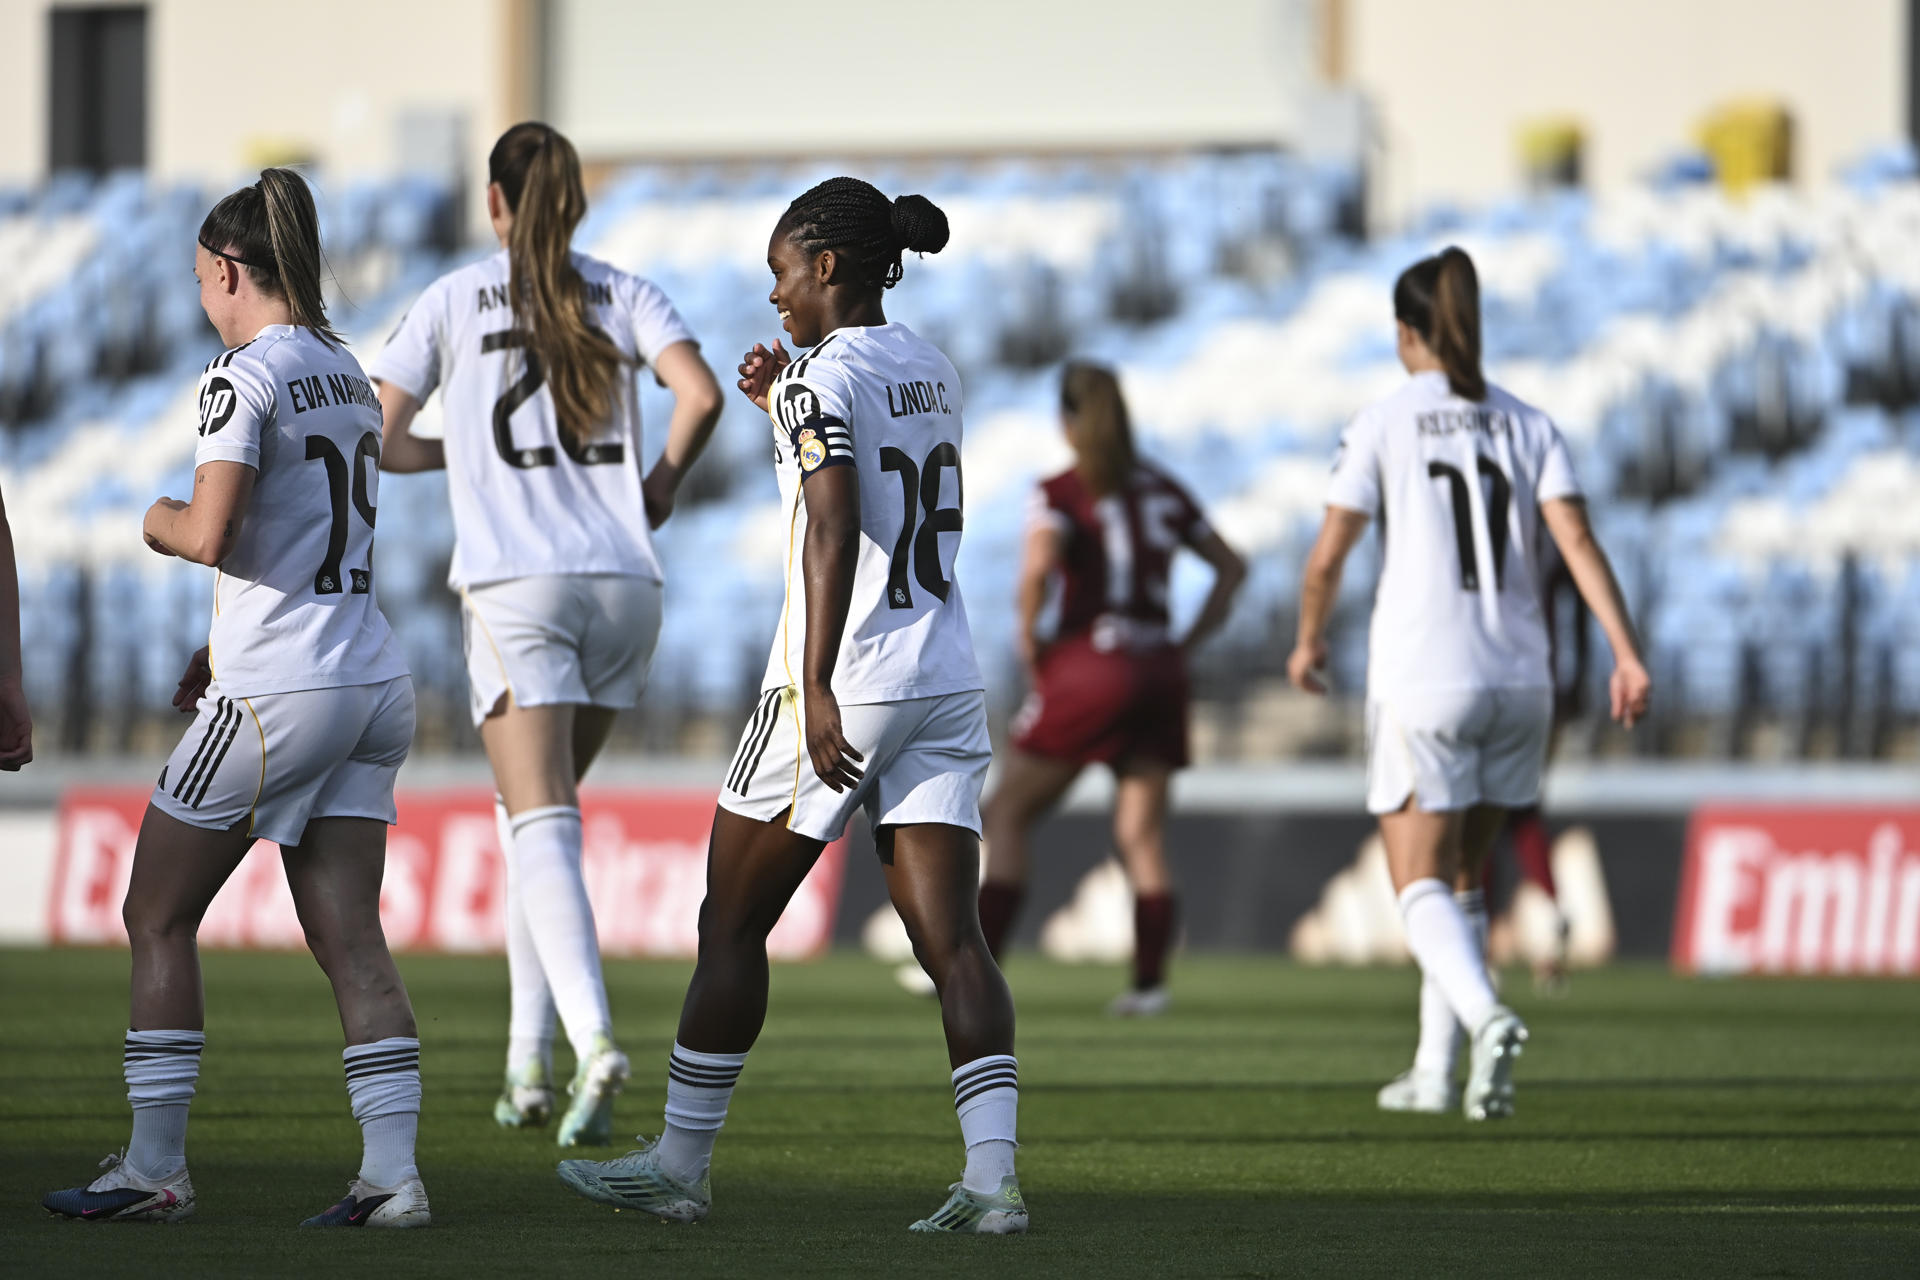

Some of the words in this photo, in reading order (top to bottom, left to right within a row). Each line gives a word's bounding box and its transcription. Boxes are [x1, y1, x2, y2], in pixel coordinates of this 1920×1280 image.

[198, 376, 237, 437] hp
[287, 375, 330, 415] EVA
[776, 383, 821, 437] hp
[885, 380, 940, 418] LINDA
[936, 380, 952, 415] C.
[879, 441, 964, 609] 18
